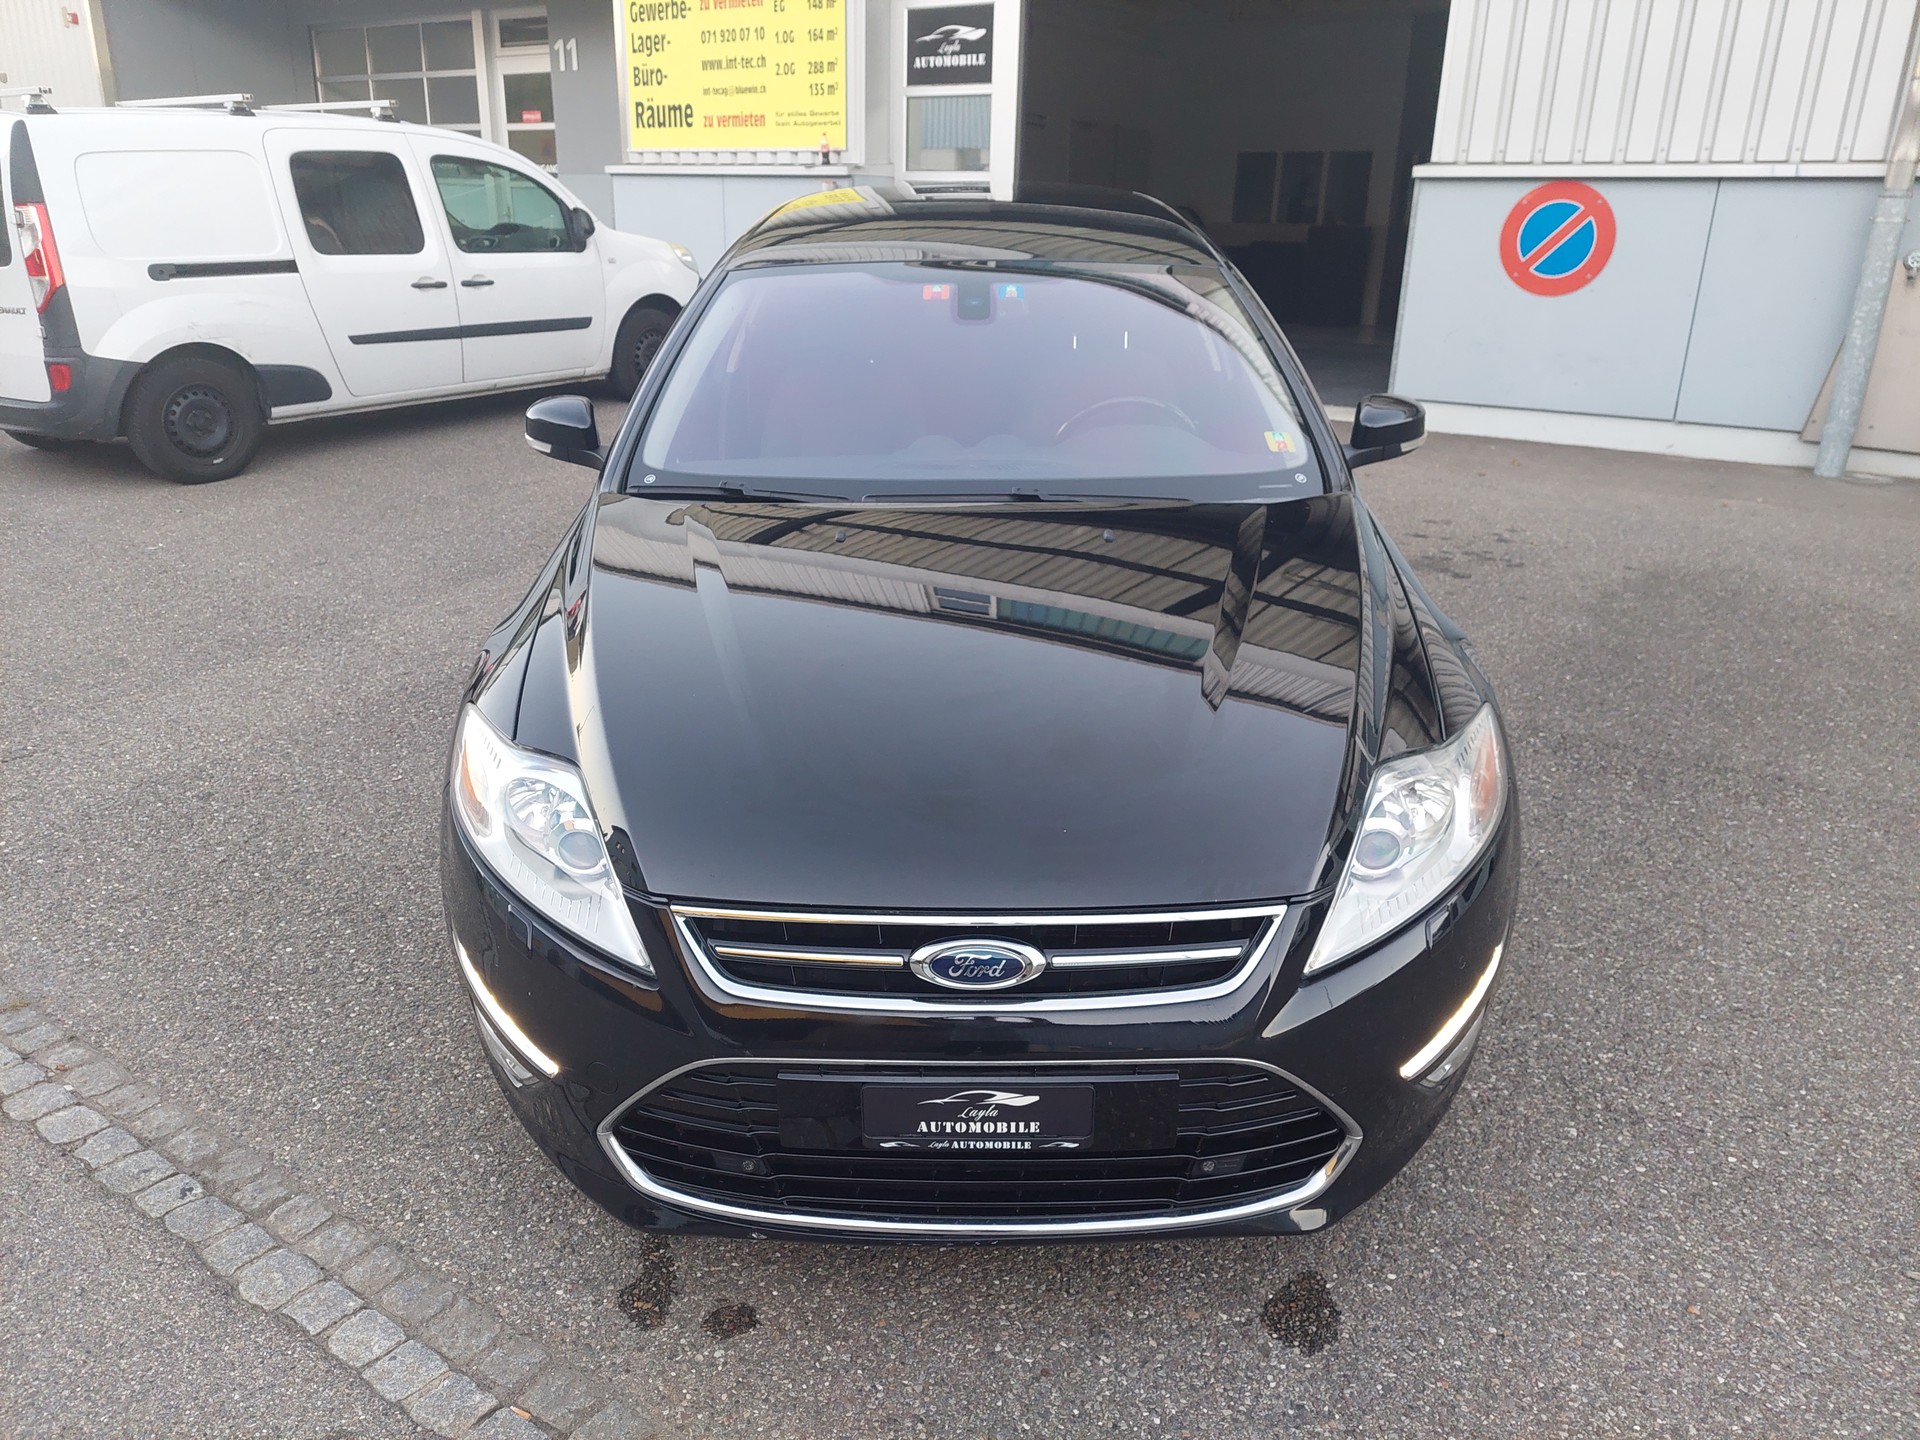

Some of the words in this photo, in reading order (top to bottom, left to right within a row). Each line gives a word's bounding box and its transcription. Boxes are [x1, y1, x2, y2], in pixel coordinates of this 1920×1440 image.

[630, 0, 691, 22] Gewerbe-
[700, 0, 710, 10] zu
[774, 0, 785, 12] EG
[808, 0, 823, 10] 148
[701, 30, 717, 44] 071
[720, 28, 737, 43] 920
[740, 27, 750, 41] 07
[754, 26, 765, 40] 10
[808, 28, 823, 41] 164
[631, 33, 671, 57] Lager-
[554, 38, 578, 71] 11
[701, 54, 766, 71] www.int-tec.ch
[913, 53, 986, 69] AUTOMOBILE
[633, 62, 667, 86] Büro-
[808, 61, 824, 74] 288
[809, 83, 824, 96] 135
[635, 98, 693, 128] Räume
[703, 114, 714, 128] zu
[717, 112, 766, 127] vermieten
[948, 953, 1007, 978] Ford
[957, 1104, 999, 1121] Layla
[917, 1121, 1040, 1133] AUTOMOBILE
[951, 1140, 1032, 1150] AUTOMOBILE
